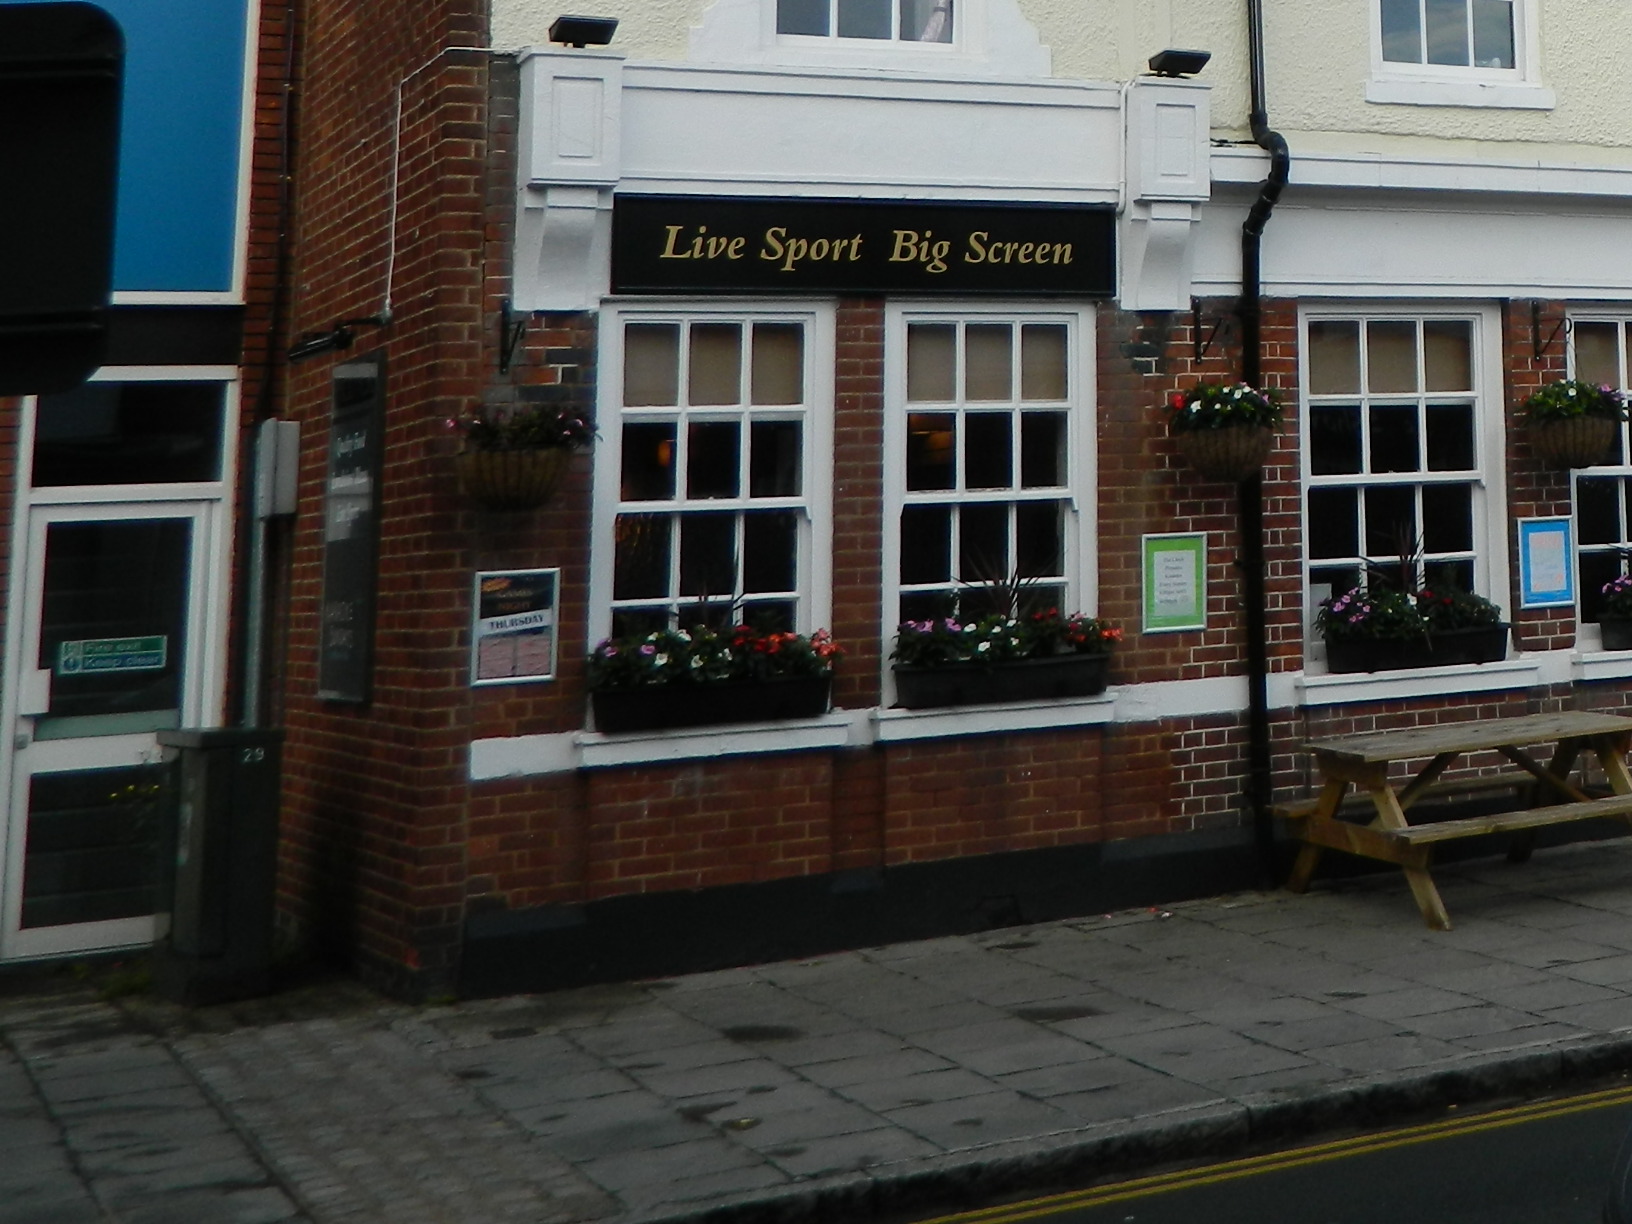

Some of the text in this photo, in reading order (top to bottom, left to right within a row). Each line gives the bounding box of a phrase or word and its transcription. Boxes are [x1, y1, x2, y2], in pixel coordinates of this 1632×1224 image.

[659, 225, 1073, 273] Live Sport Big Screen
[489, 614, 544, 630] THURSDAY
[244, 747, 265, 762] 29
